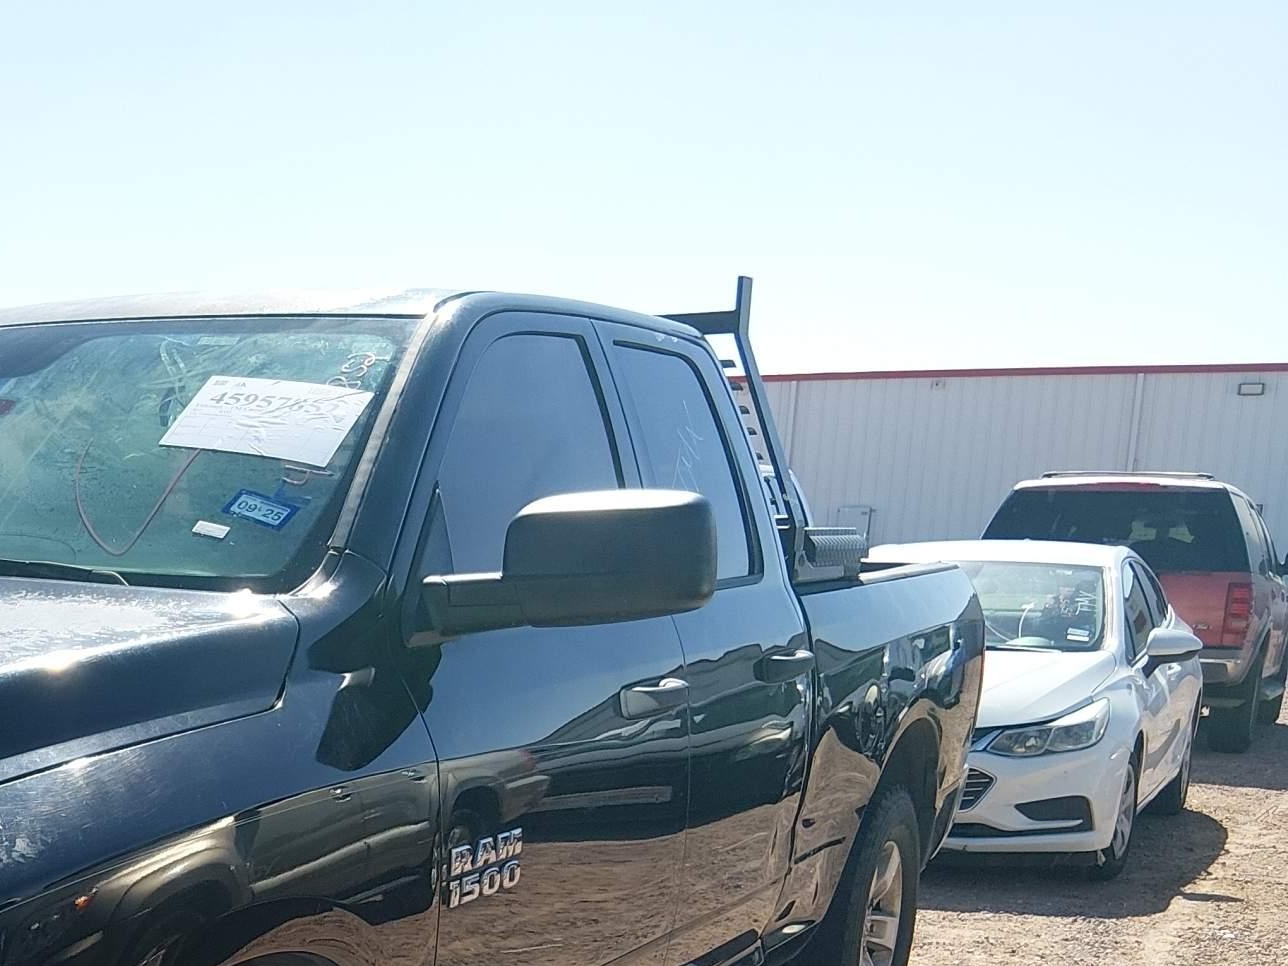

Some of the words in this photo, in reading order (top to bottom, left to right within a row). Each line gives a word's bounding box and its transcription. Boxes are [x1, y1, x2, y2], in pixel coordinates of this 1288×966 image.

[237, 500, 258, 513] 09
[262, 508, 284, 521] 25
[450, 827, 523, 877] RAM
[449, 860, 521, 909] 1500
